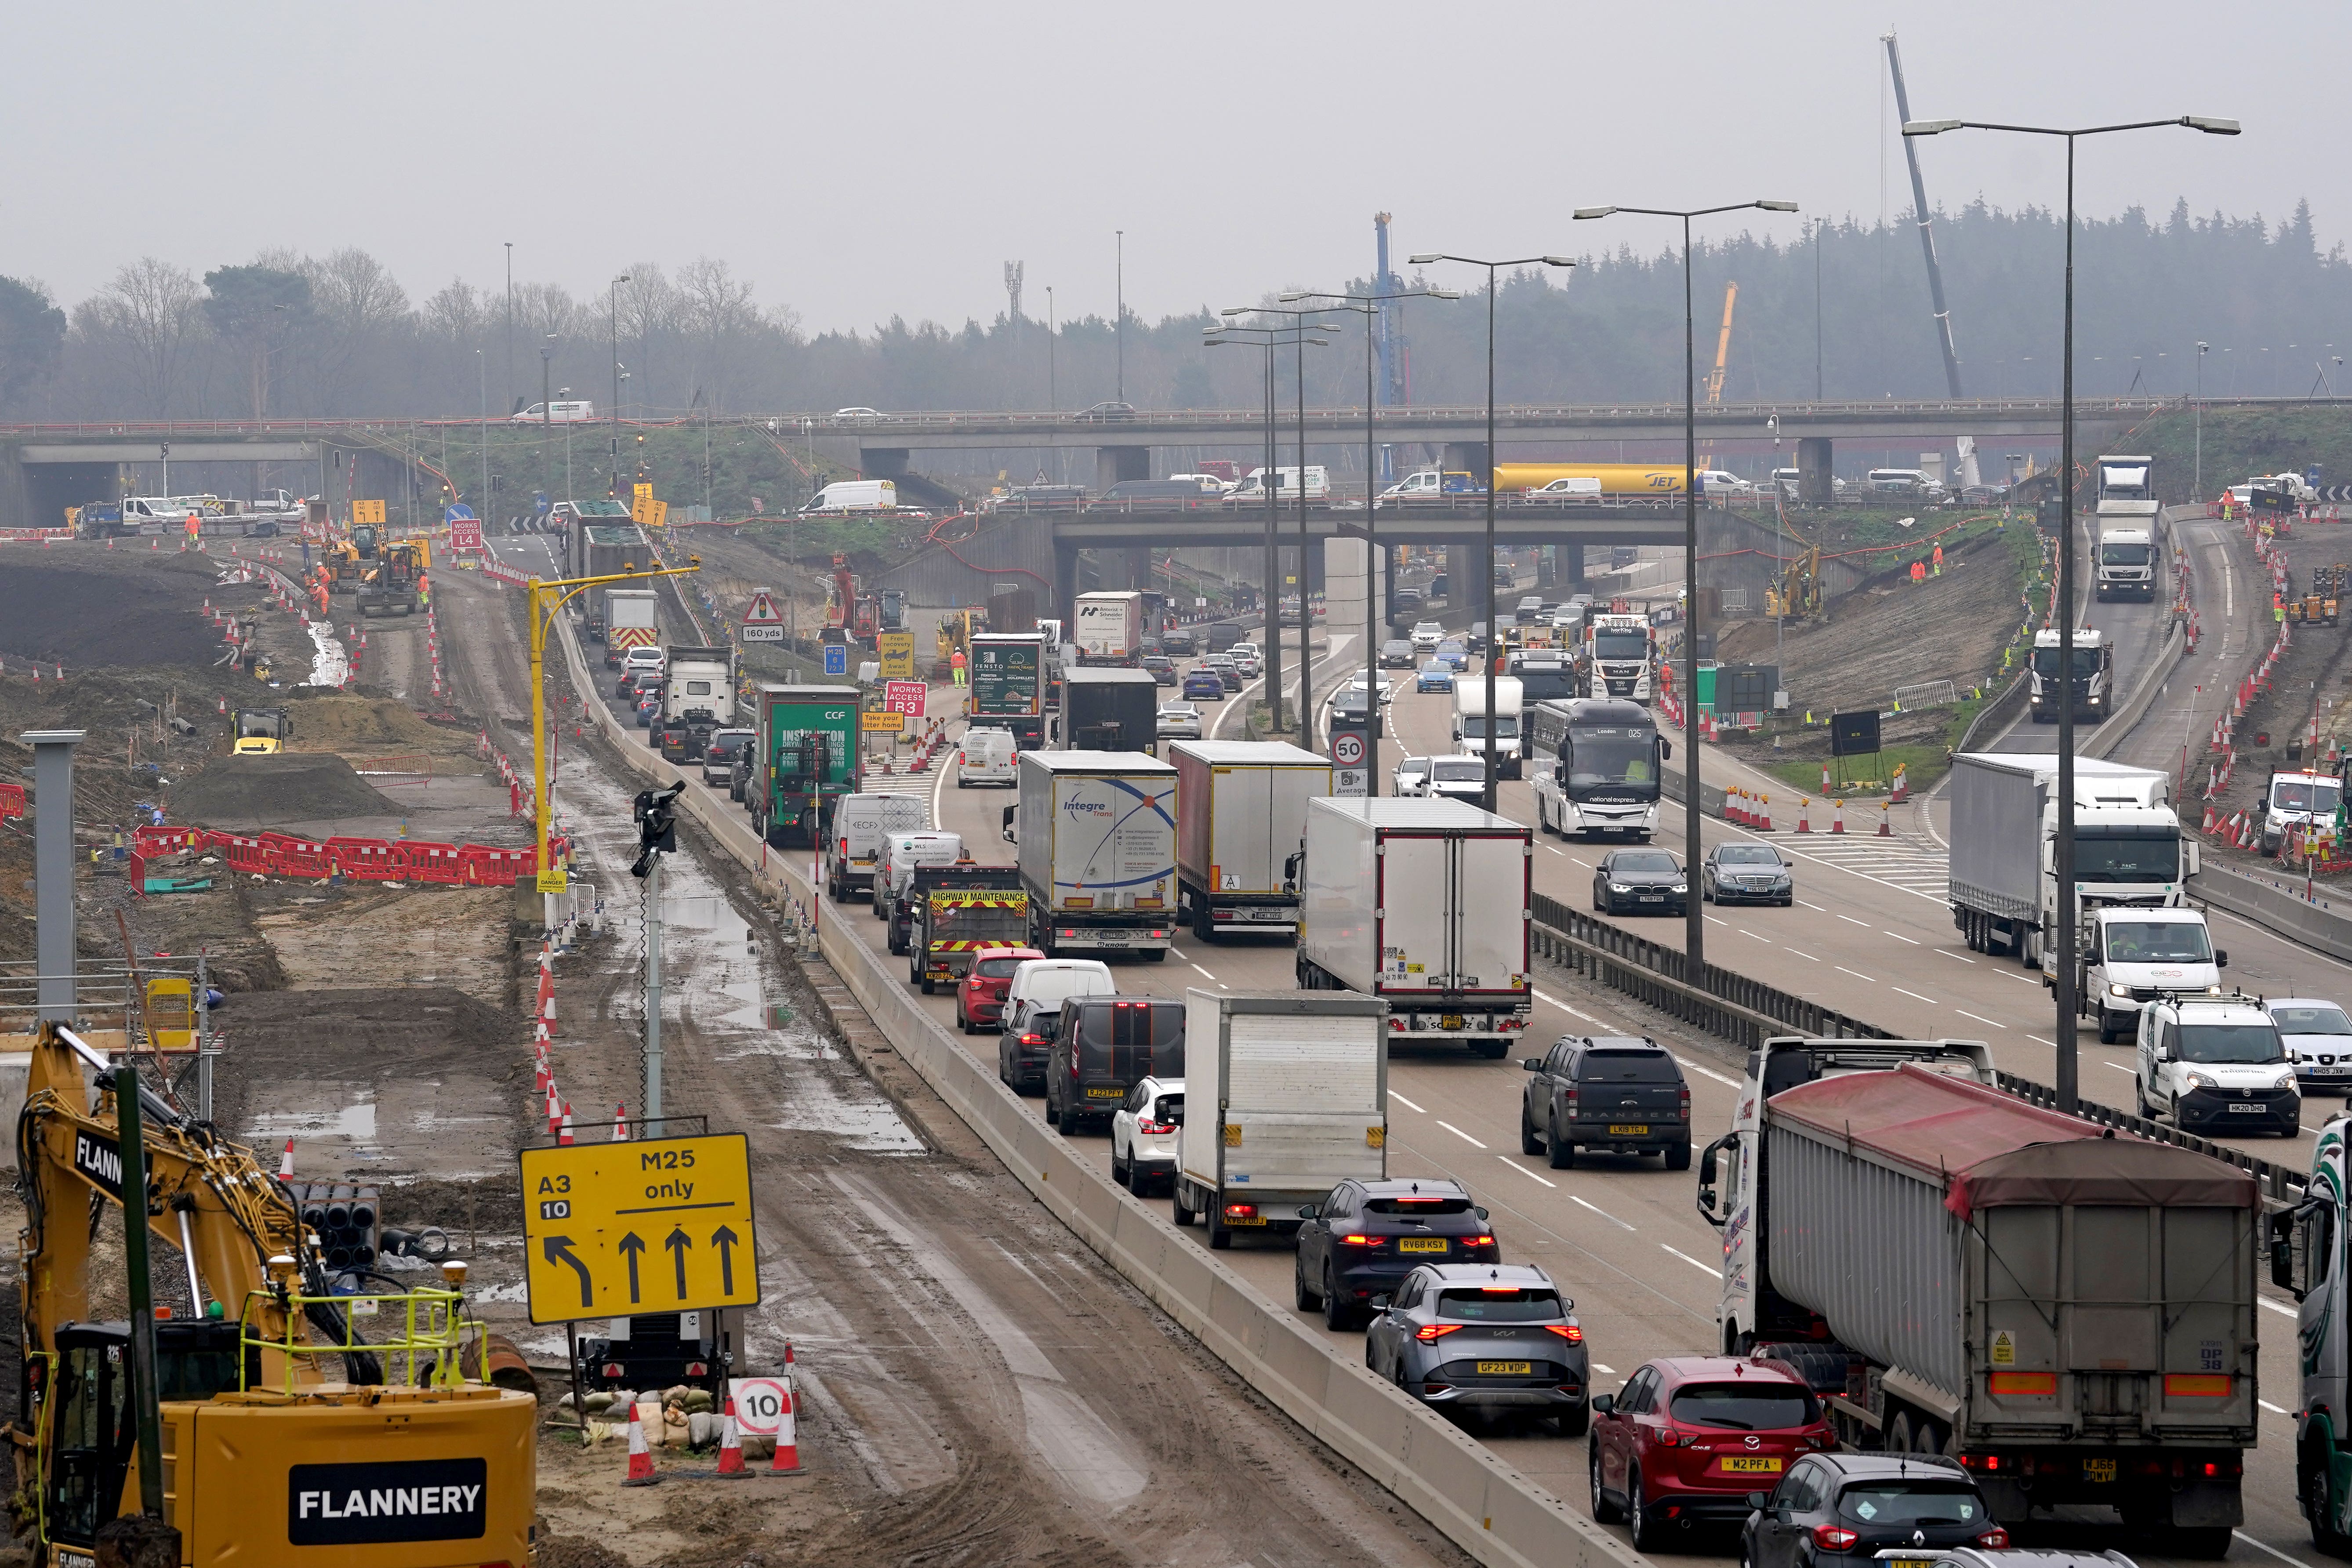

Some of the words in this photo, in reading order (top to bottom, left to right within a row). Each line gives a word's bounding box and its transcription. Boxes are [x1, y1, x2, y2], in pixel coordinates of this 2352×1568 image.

[1649, 477, 1677, 486] JET
[459, 535, 473, 545] L4
[764, 629, 780, 638] yds
[895, 702, 916, 713] B3
[1628, 729, 1641, 737] 025
[1338, 743, 1360, 756] 50
[1063, 802, 1105, 812] Integre
[1226, 877, 1235, 887] A
[933, 893, 968, 901] HIGHWAY
[970, 893, 1024, 901] MAINTENANCE
[641, 1150, 696, 1171] M25
[538, 1174, 571, 1195] A3
[645, 1179, 694, 1200] only
[543, 1201, 568, 1218] 10
[107, 1345, 120, 1363] 325
[2201, 1349, 2222, 1358] DP
[2201, 1360, 2222, 1370] 38
[747, 1395, 779, 1417] 10
[1733, 1459, 1747, 1469] M2
[1750, 1459, 1770, 1470] PFA
[2085, 1460, 2113, 1470] WJ66
[2090, 1471, 2110, 1481] DWV
[299, 1485, 481, 1519] FLANNERY
